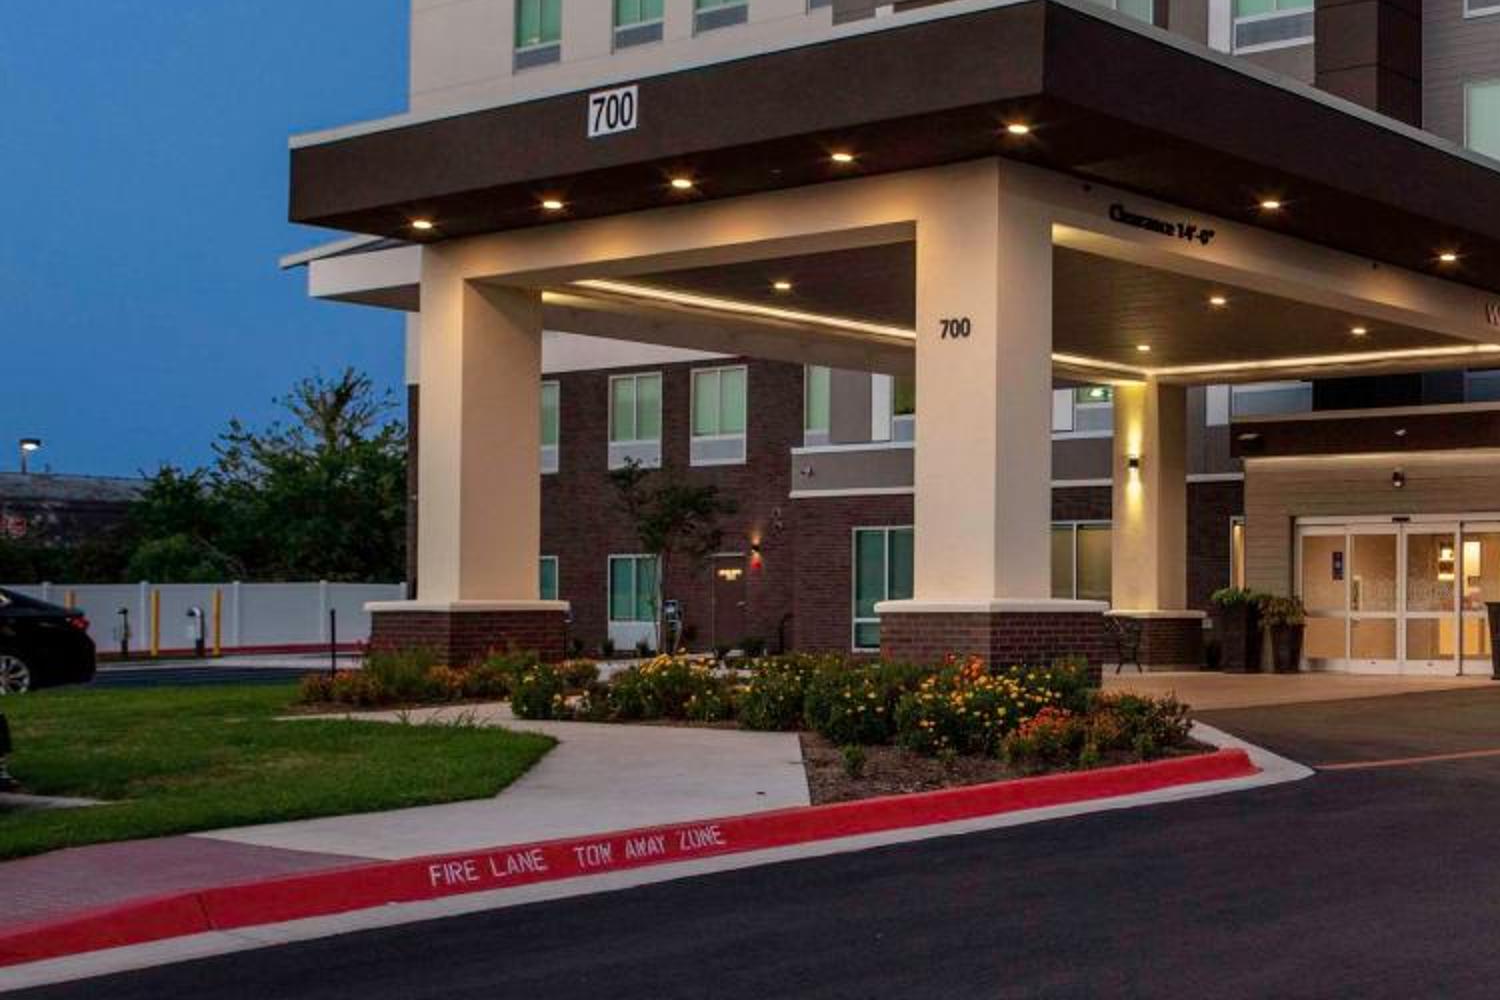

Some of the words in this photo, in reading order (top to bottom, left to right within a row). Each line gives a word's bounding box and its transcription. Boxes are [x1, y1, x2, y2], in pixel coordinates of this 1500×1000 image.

[593, 91, 634, 133] 700
[939, 316, 971, 340] 700
[428, 859, 481, 888] FIRE
[489, 847, 548, 877] LANE
[573, 842, 612, 869] TOW
[624, 834, 667, 860] AWAY
